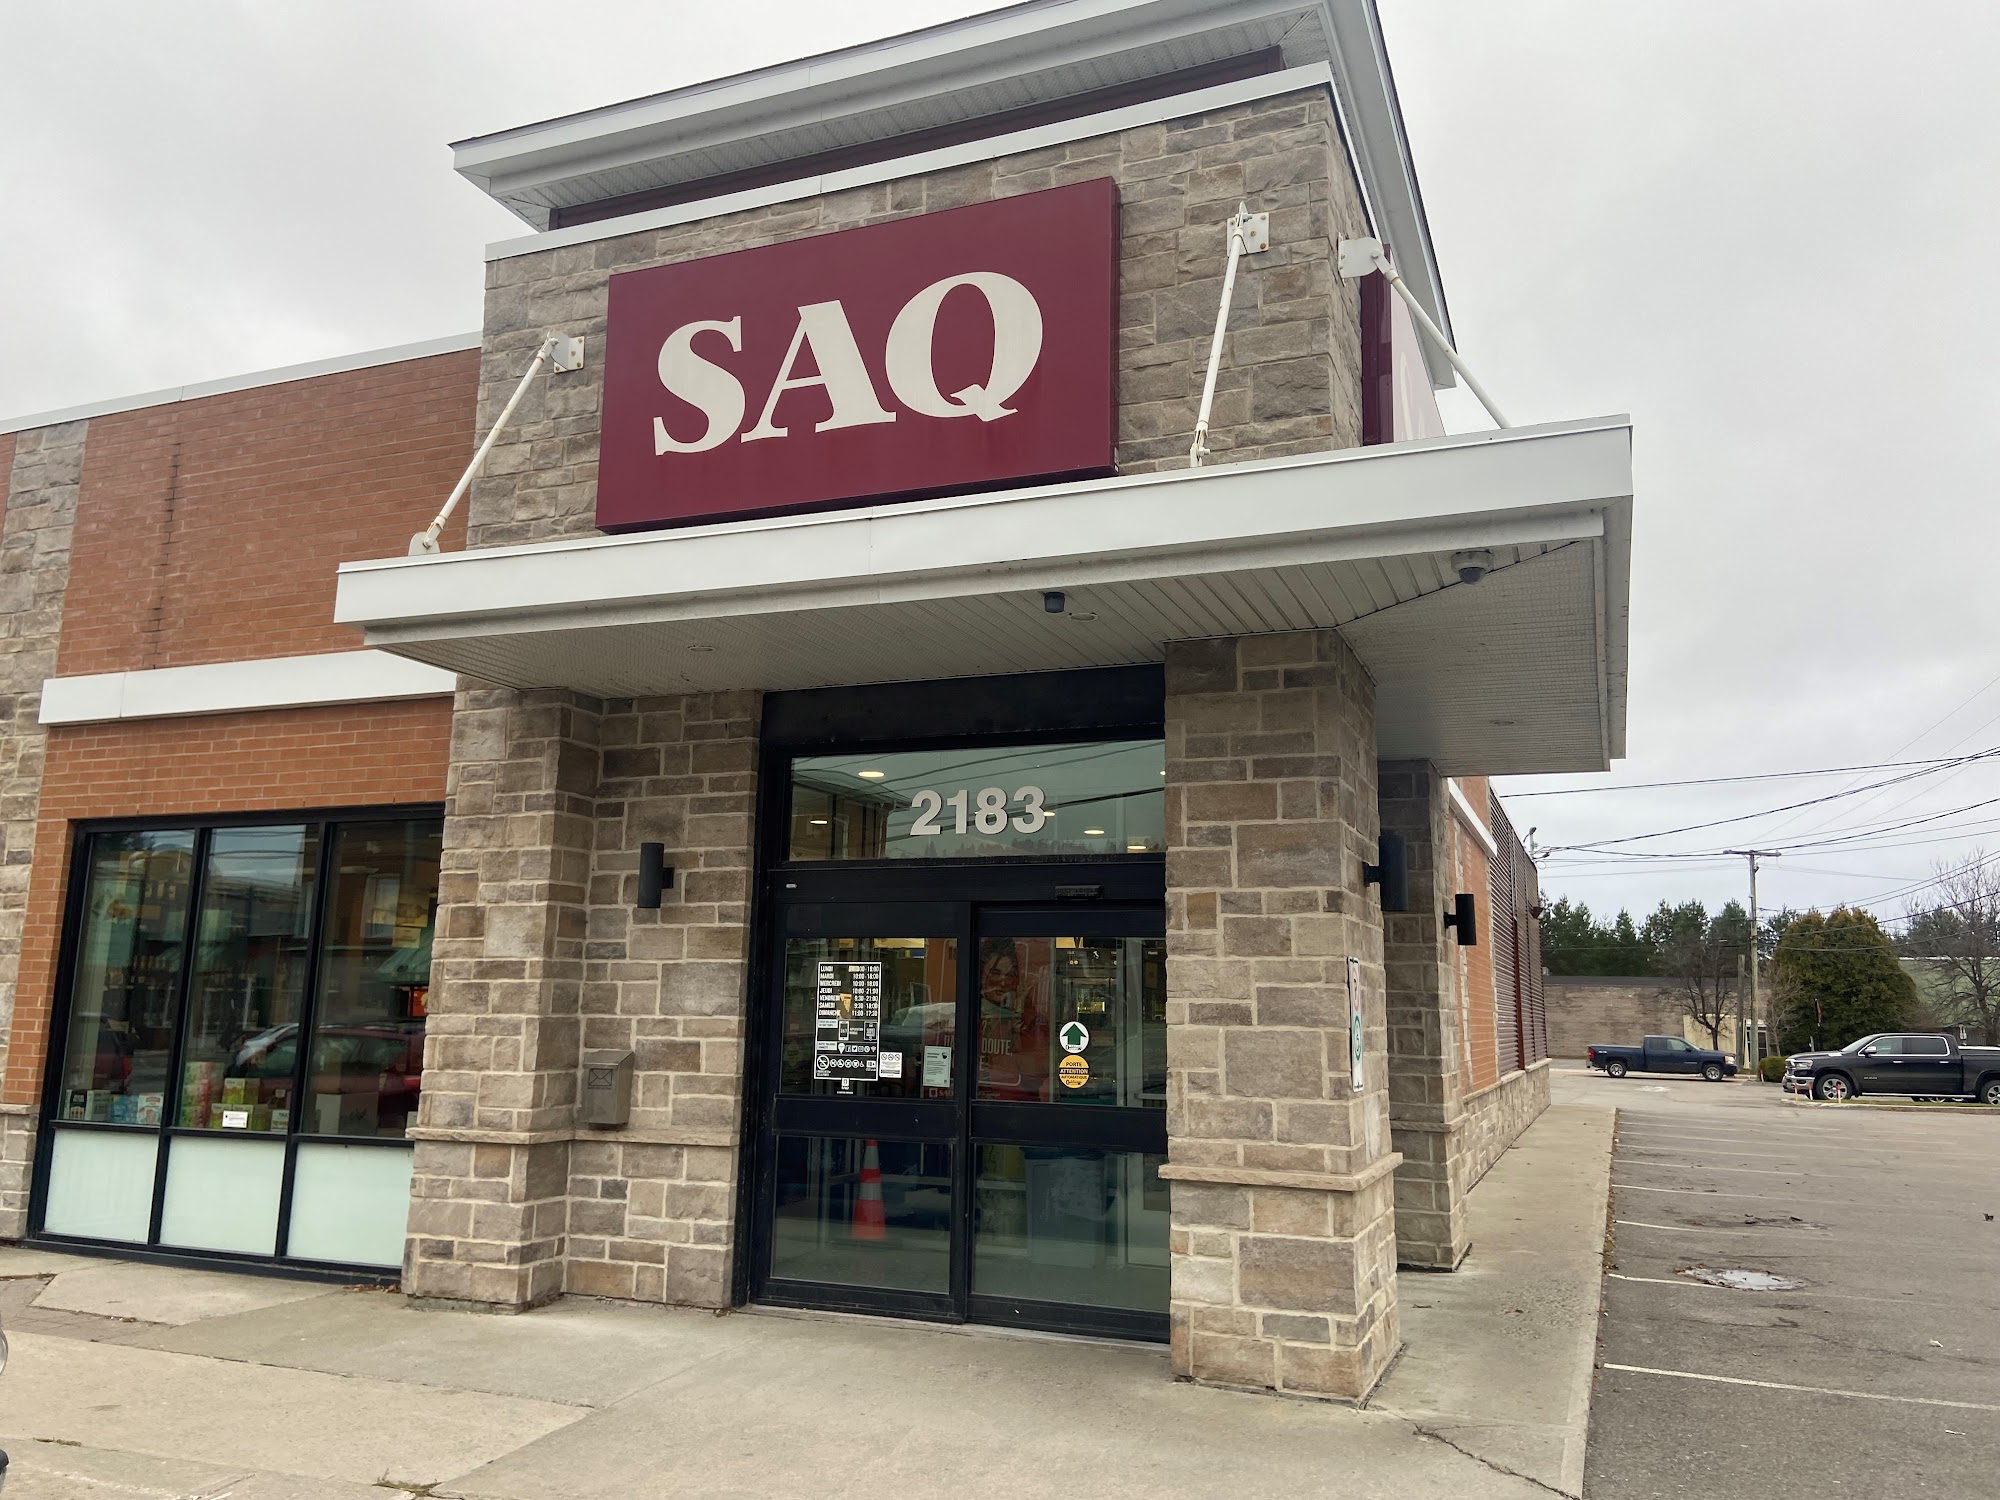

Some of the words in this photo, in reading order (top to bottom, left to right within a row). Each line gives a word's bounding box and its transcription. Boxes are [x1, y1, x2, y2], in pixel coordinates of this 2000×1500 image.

[653, 271, 1044, 456] SAQ
[910, 786, 1046, 835] 2183
[981, 1037, 1013, 1056] DOUTE,
